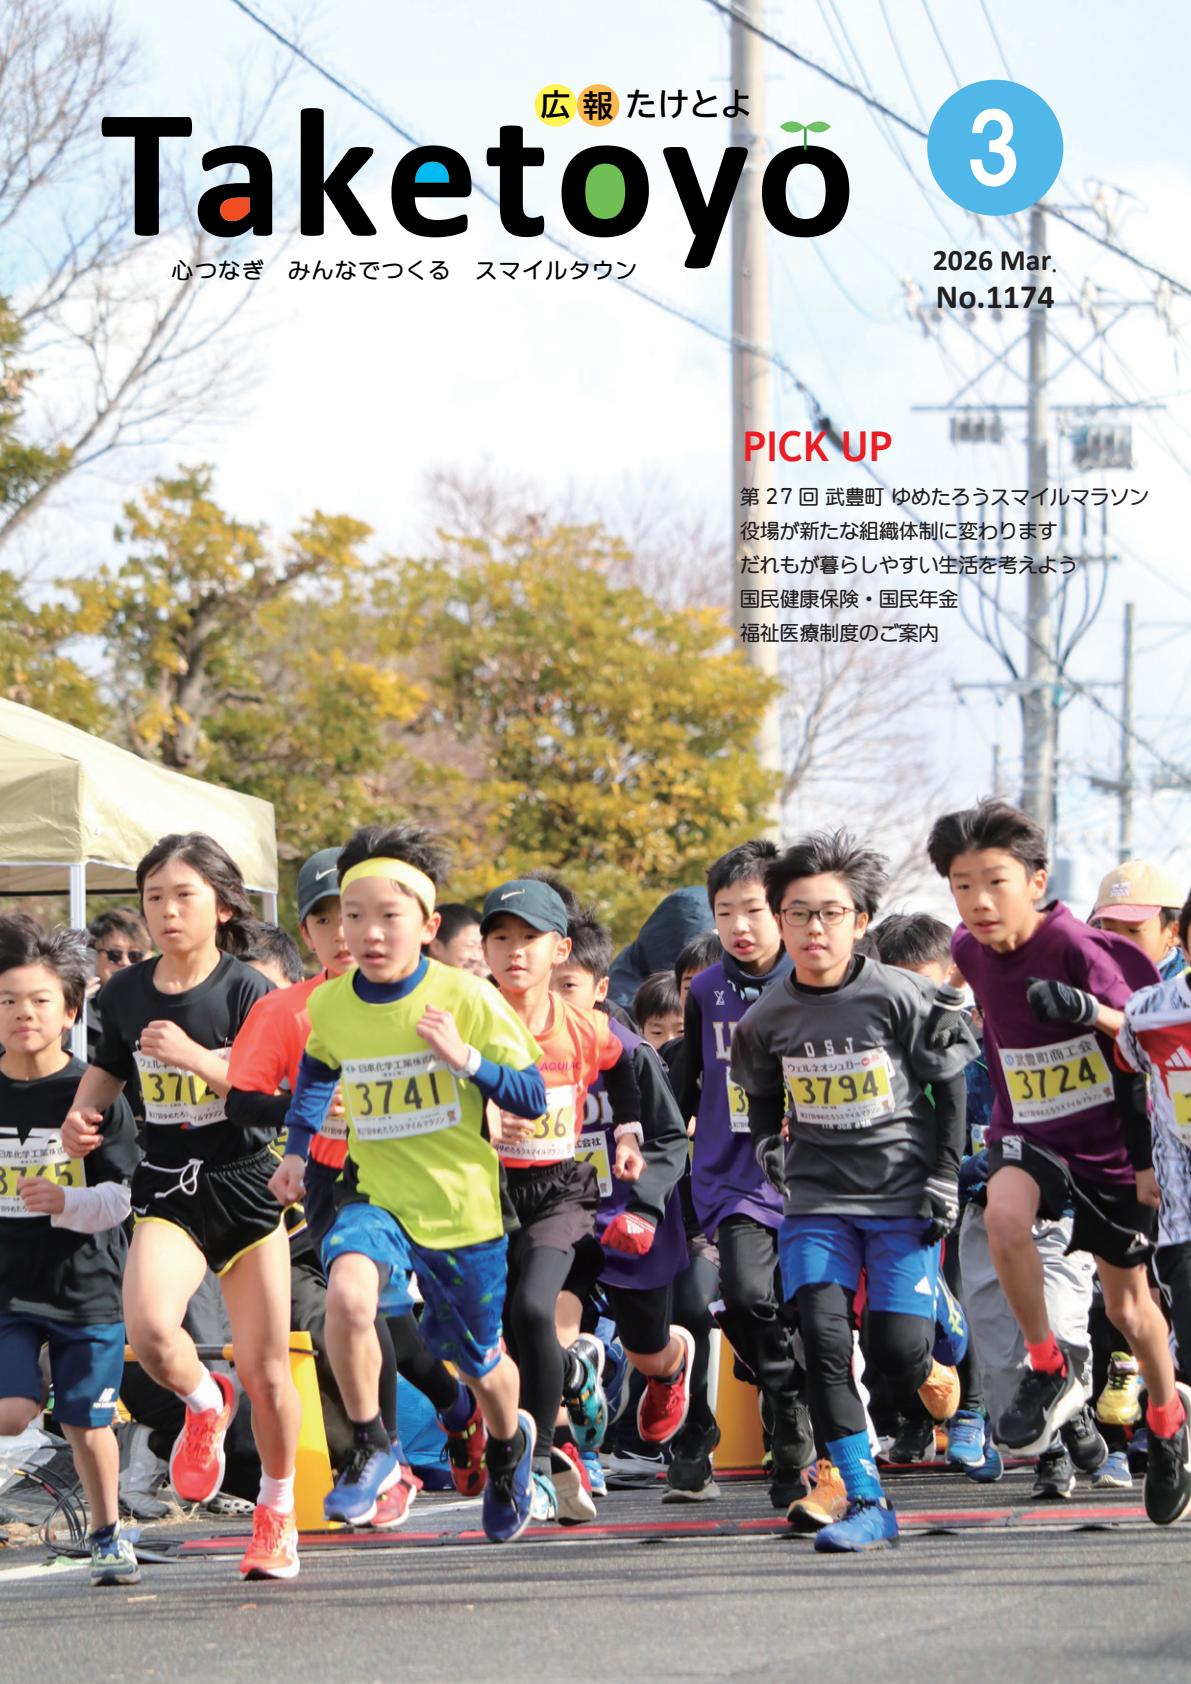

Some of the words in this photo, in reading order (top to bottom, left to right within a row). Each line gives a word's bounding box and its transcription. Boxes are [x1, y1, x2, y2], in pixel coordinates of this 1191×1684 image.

[787, 1060, 861, 1073] ウェルネオシュガー
[1015, 1057, 1097, 1100] 3724
[355, 1072, 440, 1116] 3741
[798, 1071, 879, 1104] 3794
